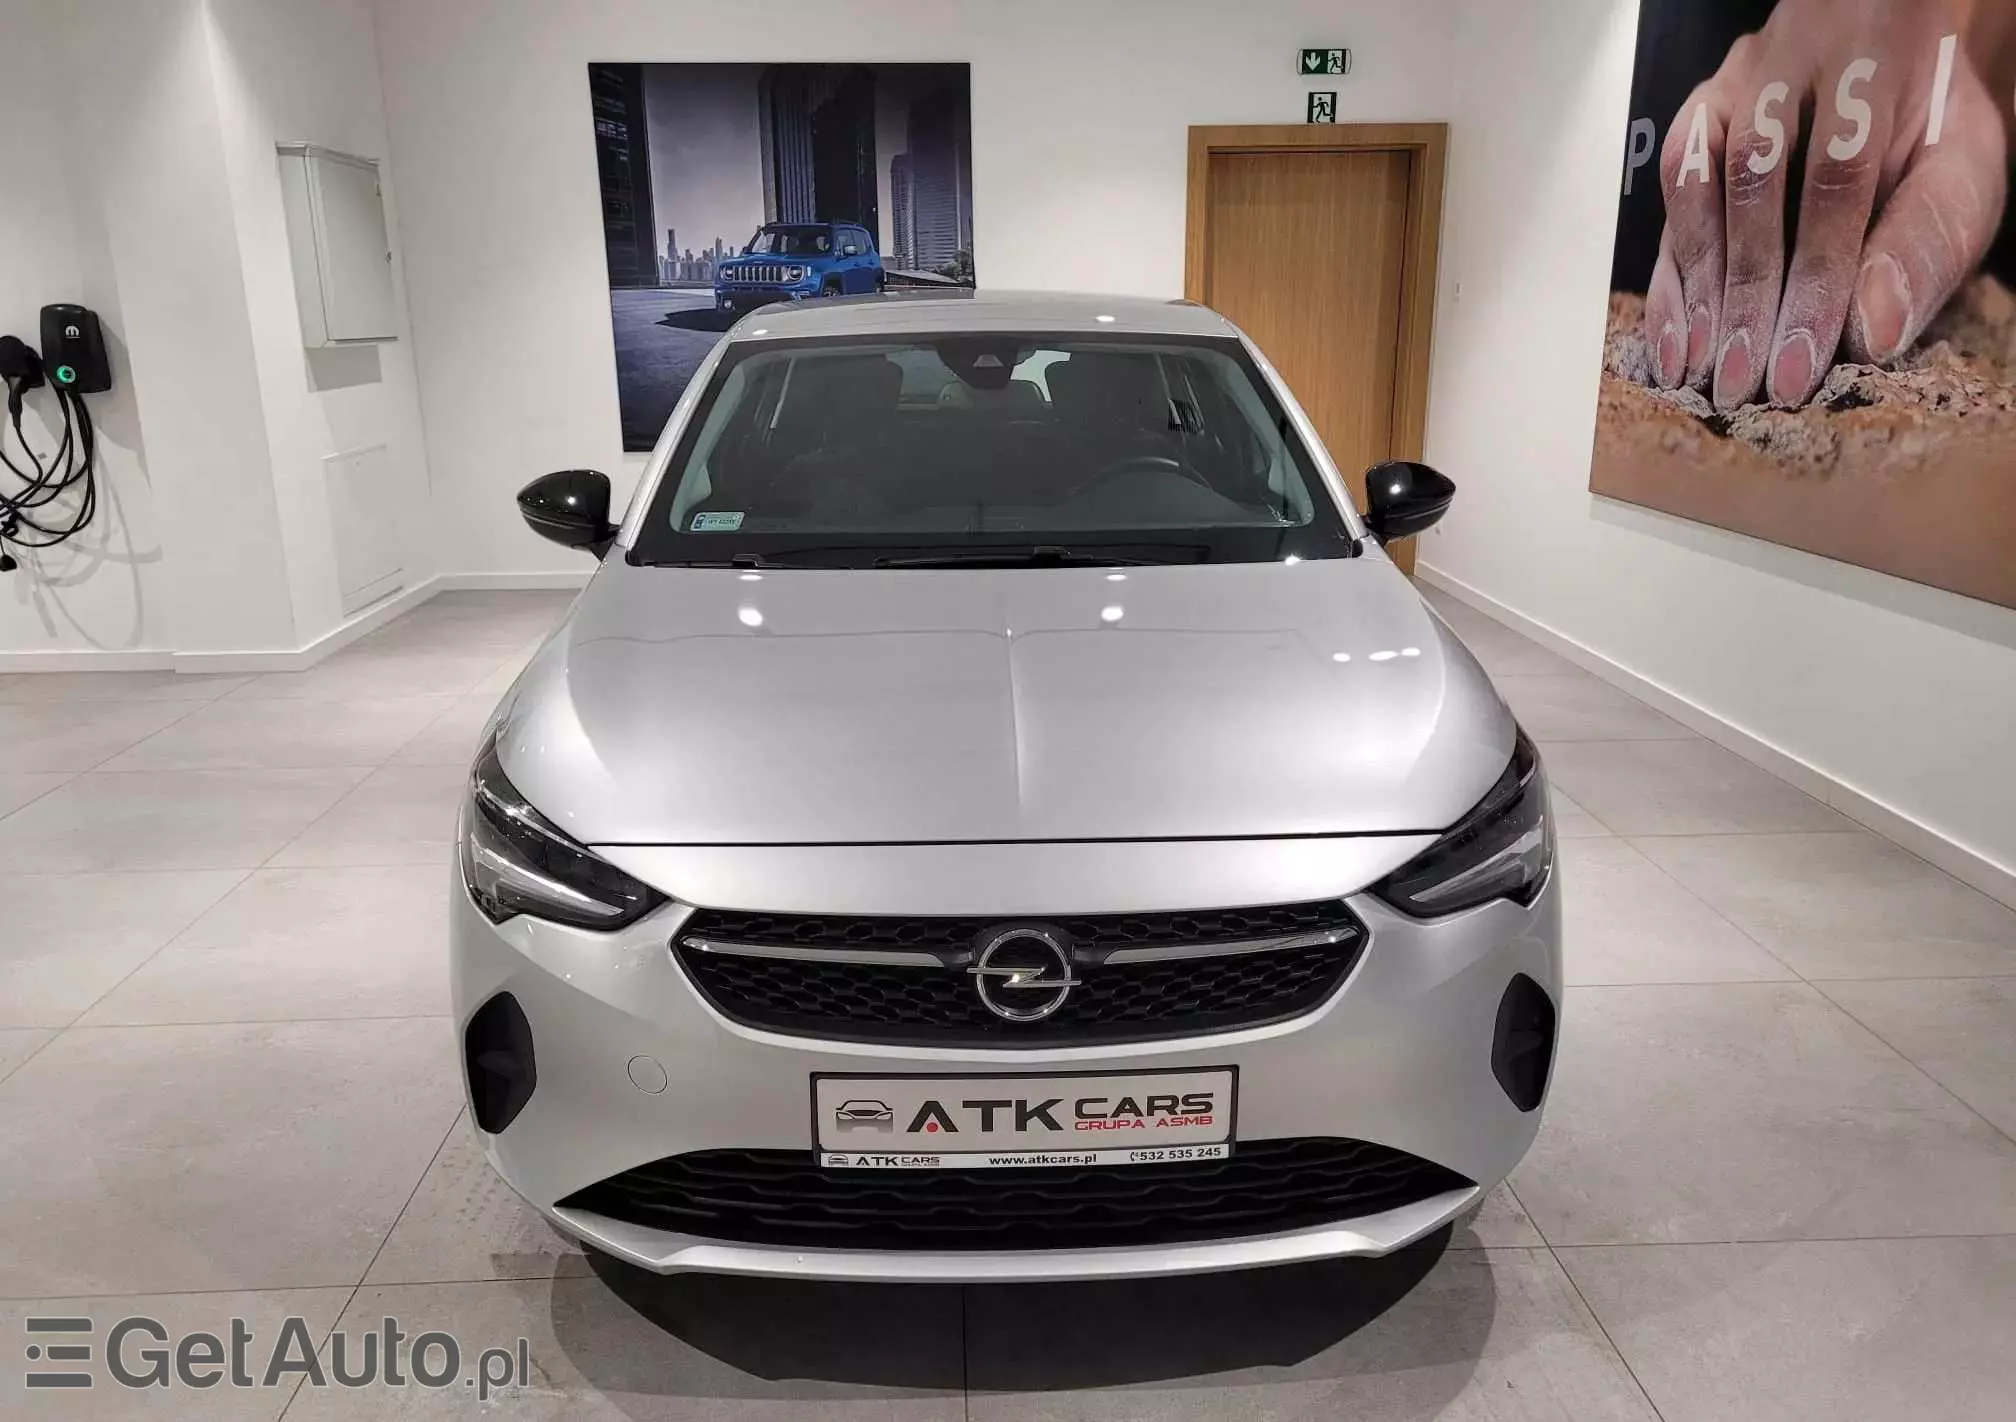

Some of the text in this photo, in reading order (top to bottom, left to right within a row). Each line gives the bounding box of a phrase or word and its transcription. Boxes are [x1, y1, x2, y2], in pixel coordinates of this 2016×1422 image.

[1624, 33, 2016, 196] PASSI
[906, 1092, 1214, 1133] ATK CARS
[1074, 1115, 1214, 1131] GRUPA ASMB
[855, 1156, 899, 1167] ATK
[901, 1156, 941, 1164] CARS
[988, 1153, 1098, 1166] www.atkcars.pl
[1139, 1147, 1222, 1161] 532 535 245
